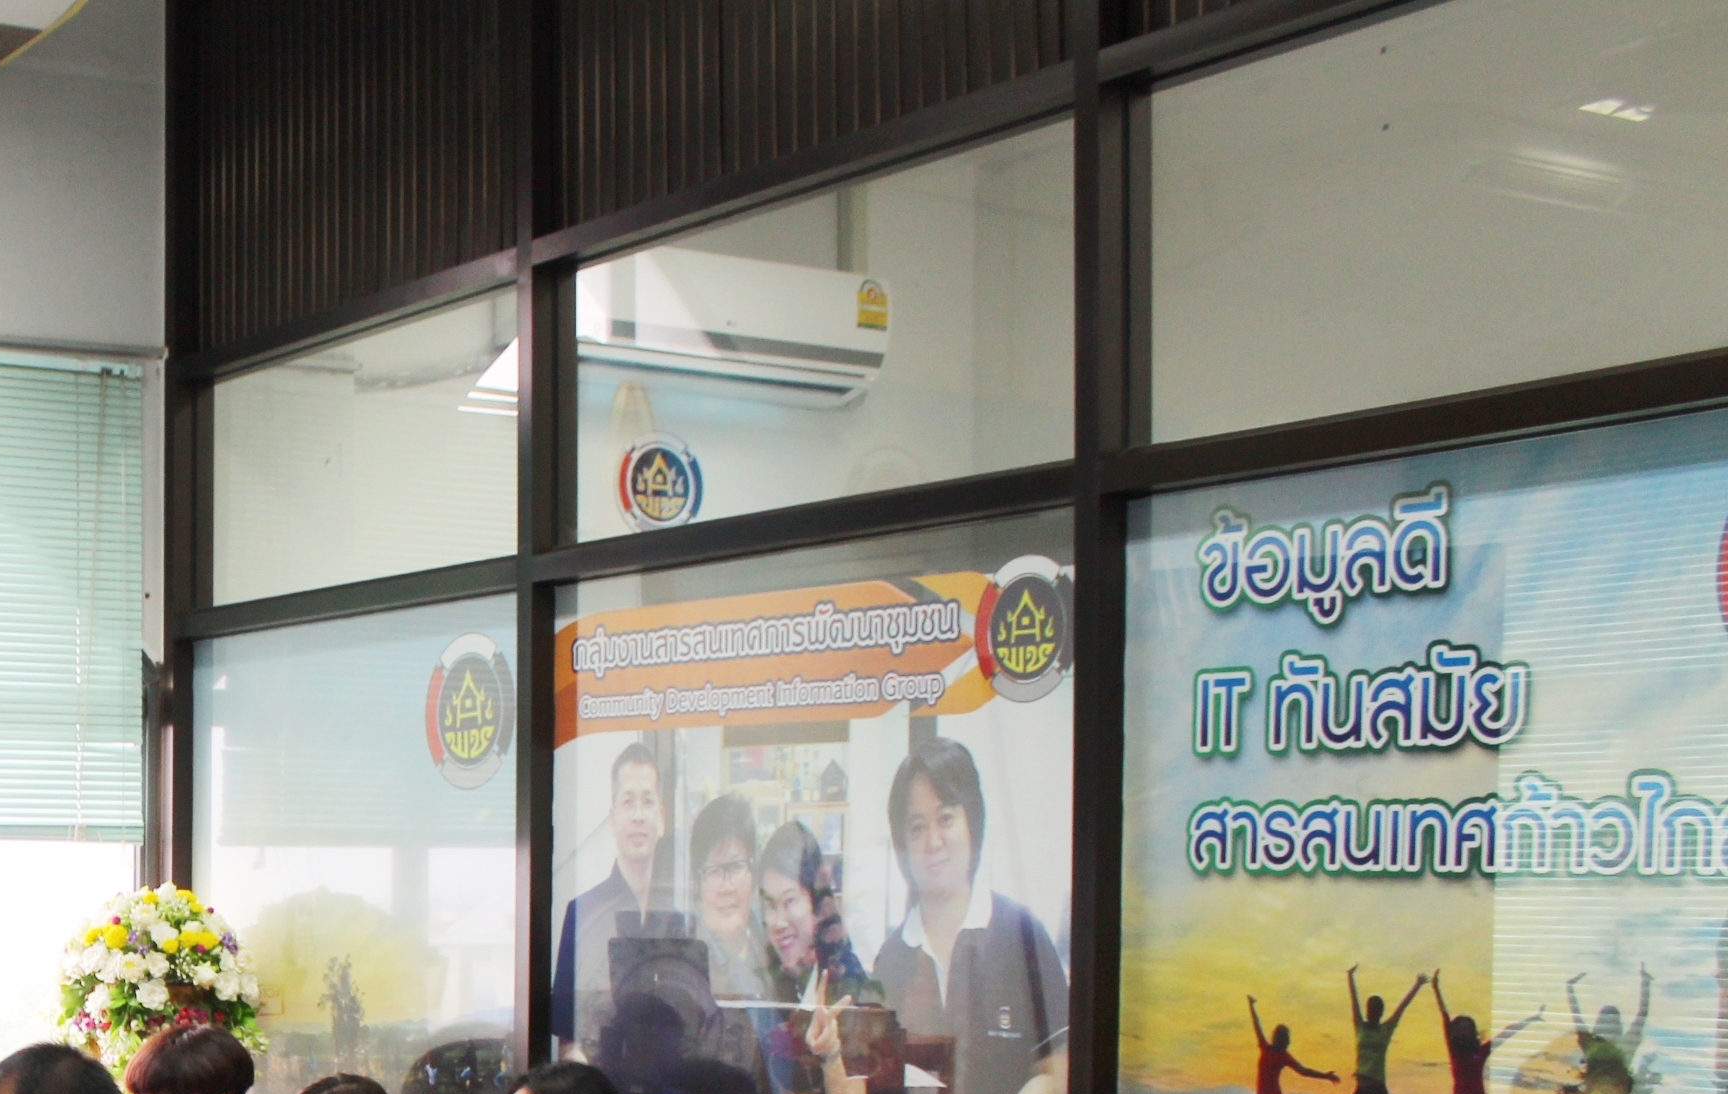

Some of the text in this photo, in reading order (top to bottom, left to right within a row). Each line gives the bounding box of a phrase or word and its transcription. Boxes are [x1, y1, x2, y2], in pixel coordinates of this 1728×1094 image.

[1201, 486, 1447, 623] ข้อมูลดี
[573, 601, 960, 679] กลุ่มงานสารสนเทศการพัฒนาชุมชน
[579, 672, 945, 720] Community Development Information Group
[1197, 648, 1526, 752] IT ทันสมัย
[1192, 774, 1728, 874] สารสนเทศก้าวไก
